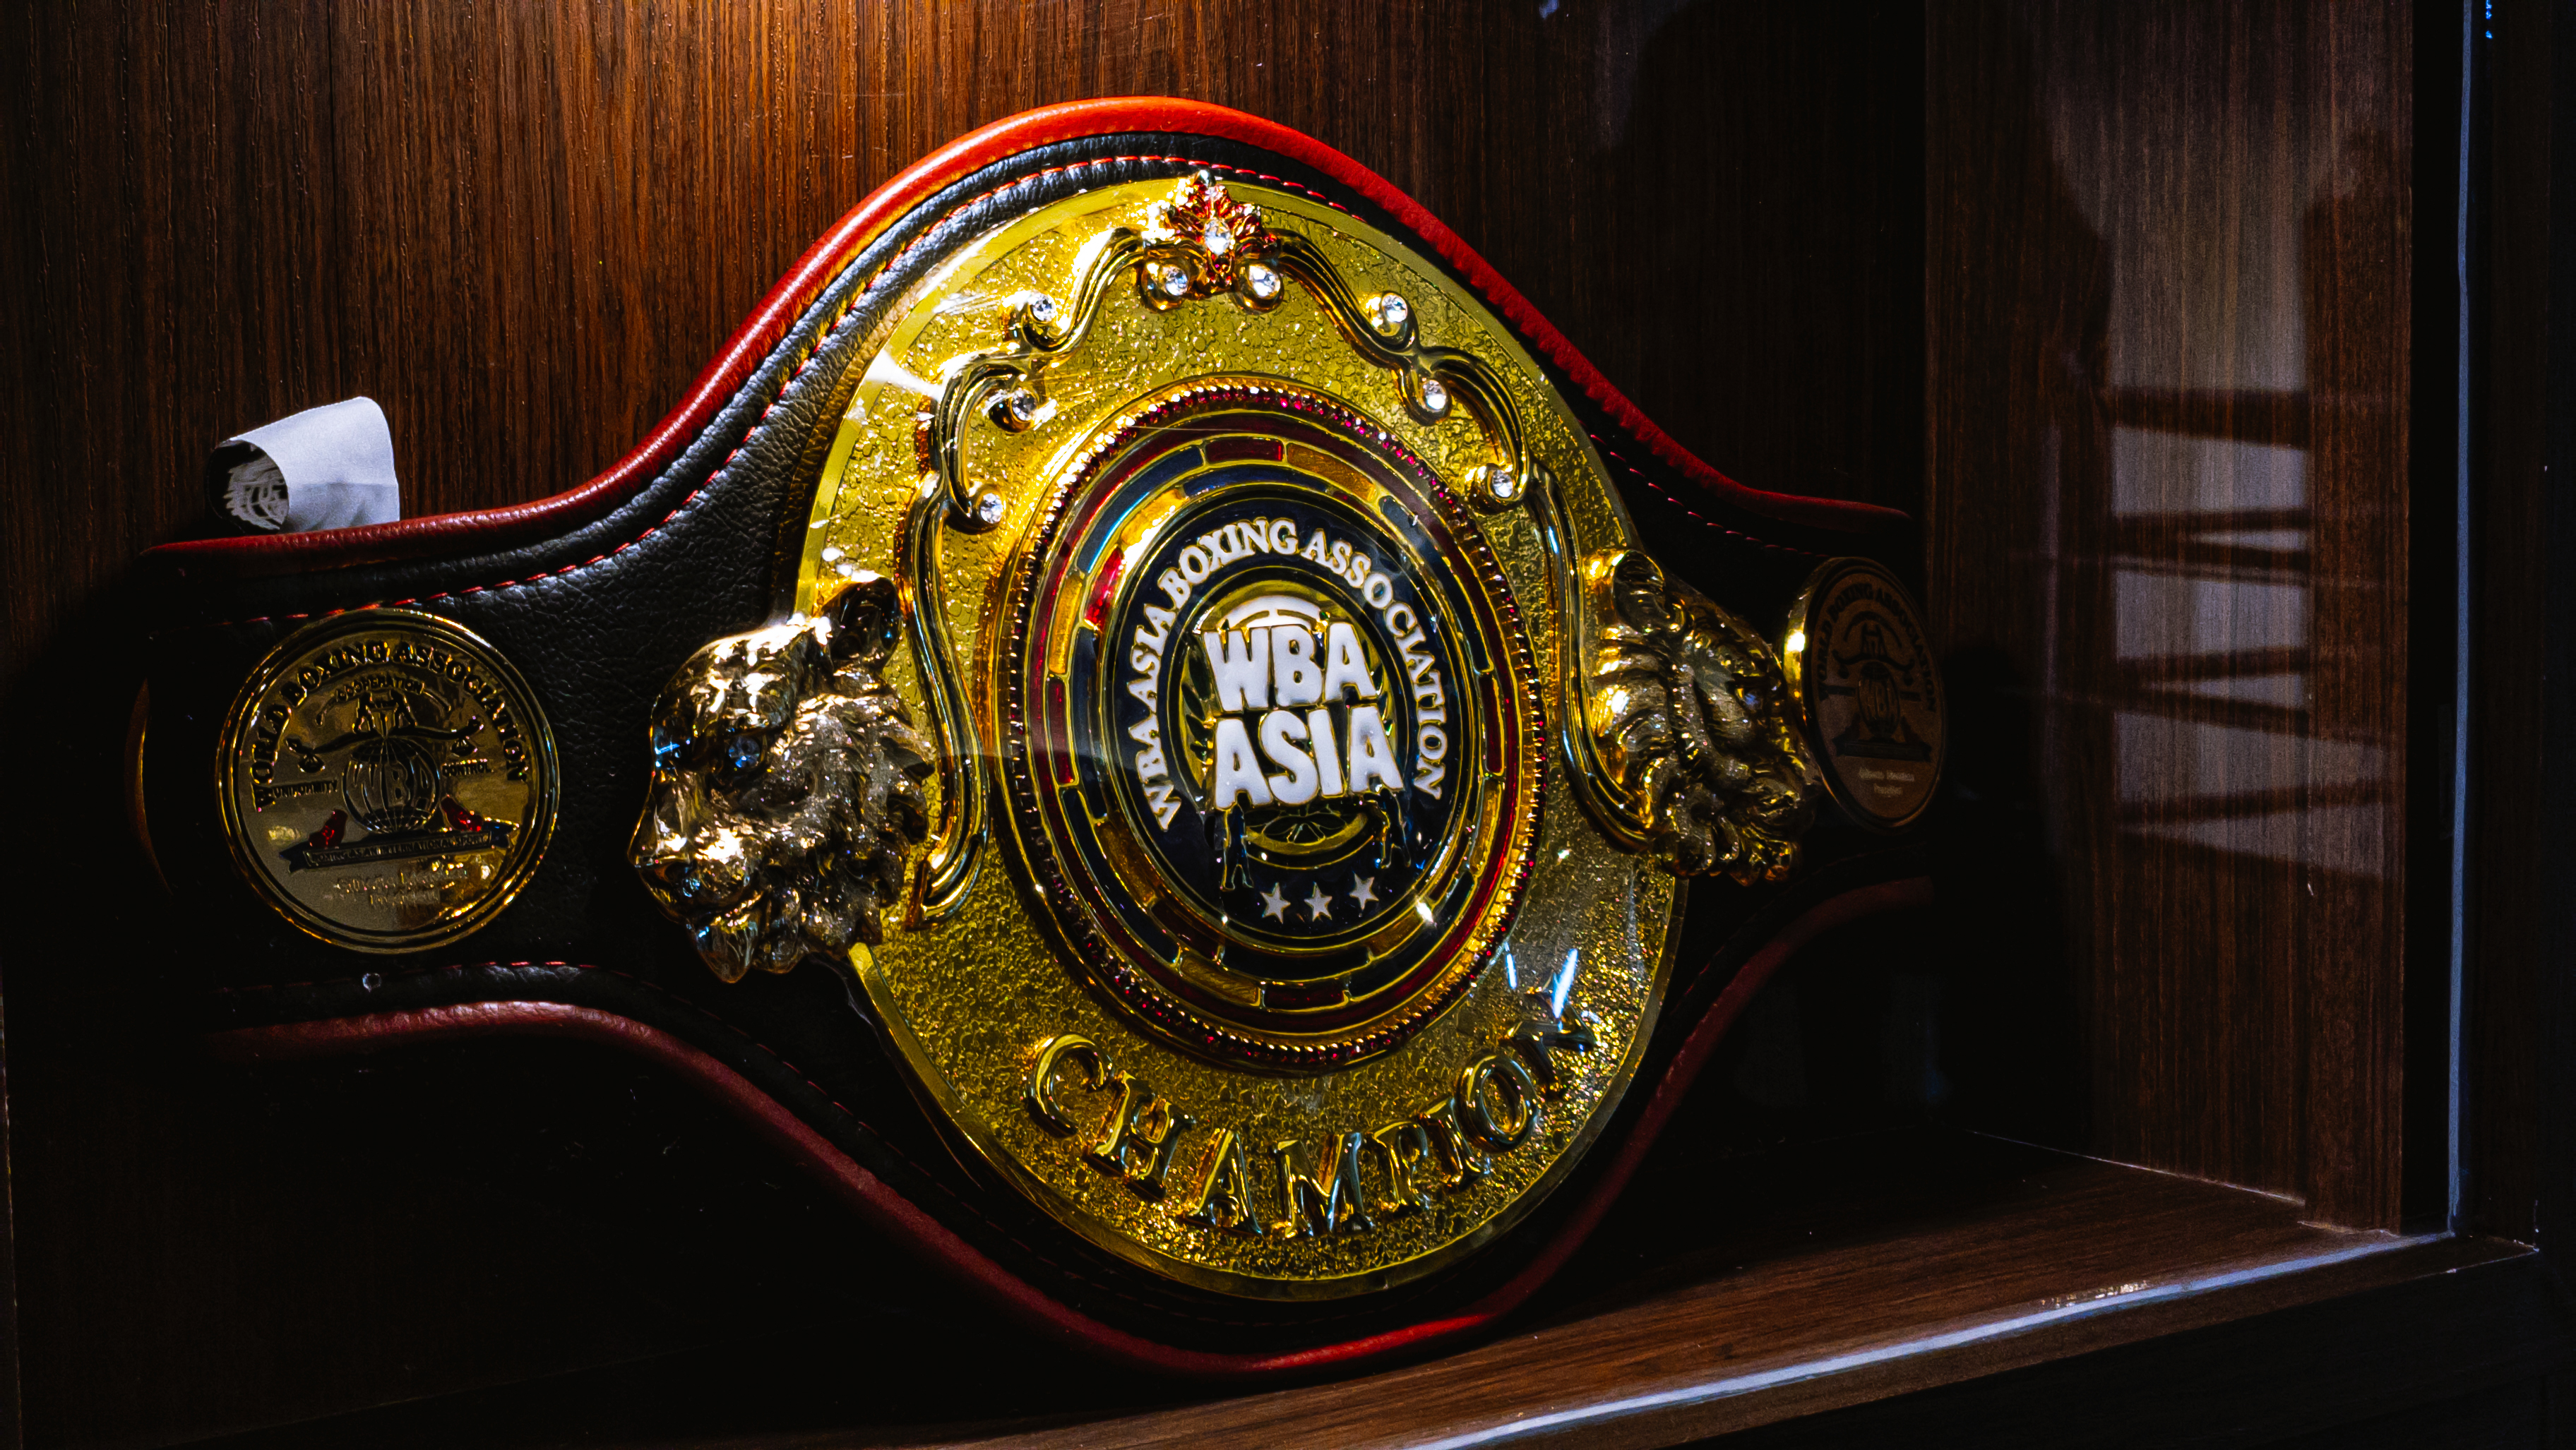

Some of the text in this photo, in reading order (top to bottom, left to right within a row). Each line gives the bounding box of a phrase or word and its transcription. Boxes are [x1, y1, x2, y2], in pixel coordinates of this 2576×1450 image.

[282, 642, 390, 705] BOXING
[393, 642, 528, 783] ASSOCIATION
[336, 675, 425, 702] COOPERATION
[1128, 517, 1448, 832] WBA ASIA BOXING ASSOCIATION
[1202, 622, 1377, 713] WBA
[273, 779, 338, 798] UNIFORMITY
[442, 759, 492, 777] CONTROL
[1214, 705, 1404, 810] ASIA
[1022, 987, 1596, 1240] CHAMPION
